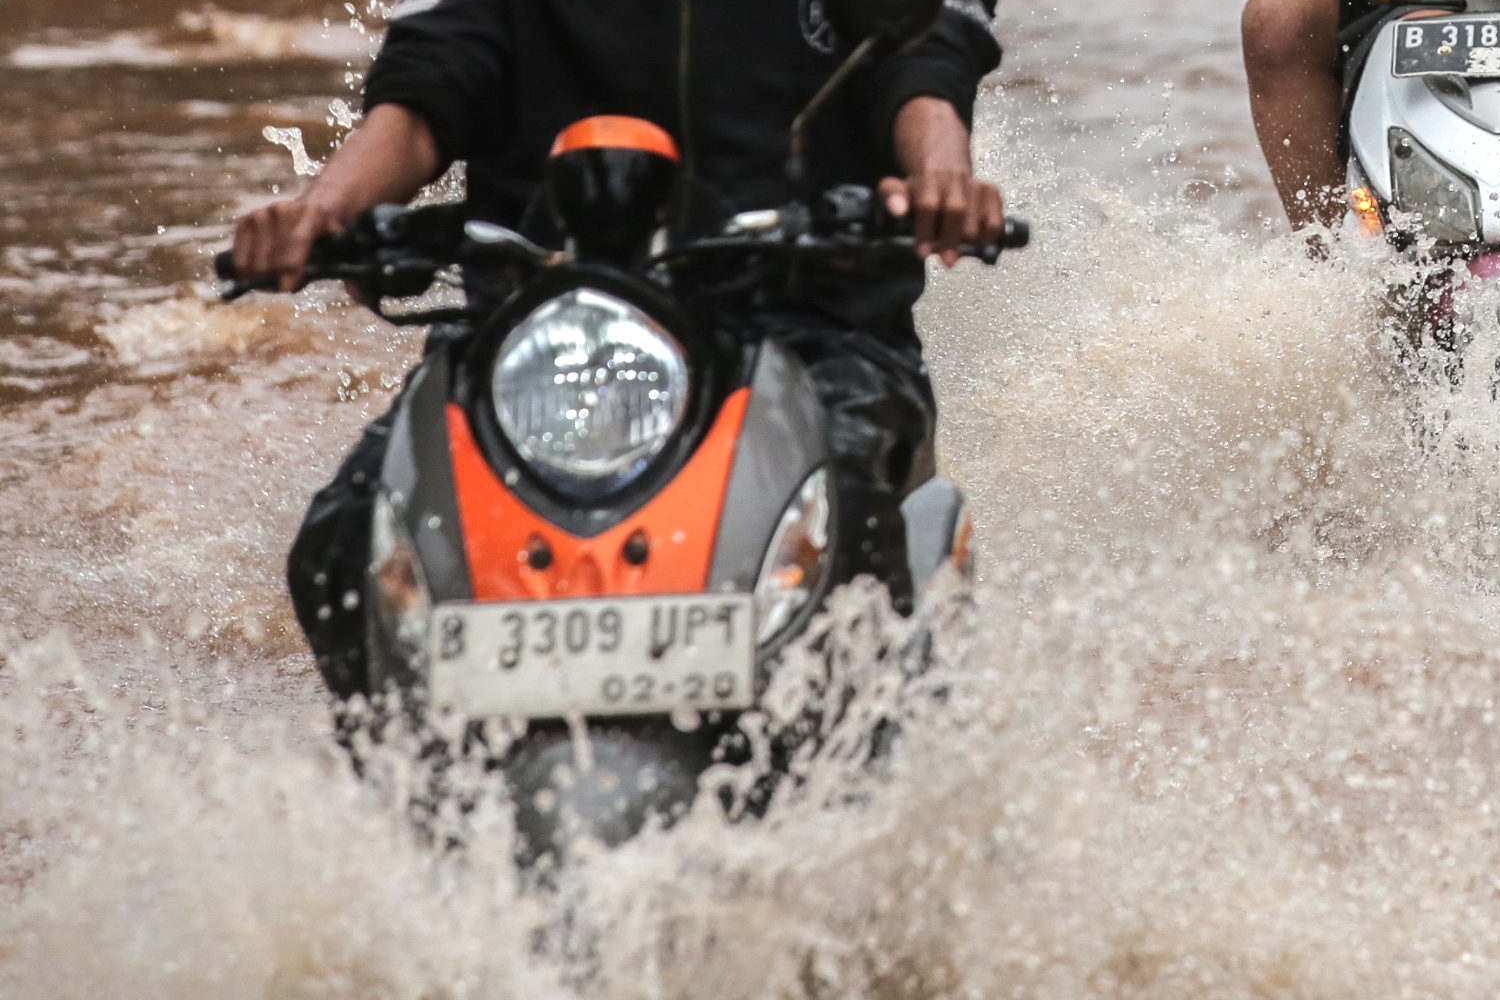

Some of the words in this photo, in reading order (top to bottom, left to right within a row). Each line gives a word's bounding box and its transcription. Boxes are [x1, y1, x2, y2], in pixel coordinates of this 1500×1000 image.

[1405, 26, 1424, 49] B
[440, 614, 466, 660] B
[501, 606, 623, 656] 3309
